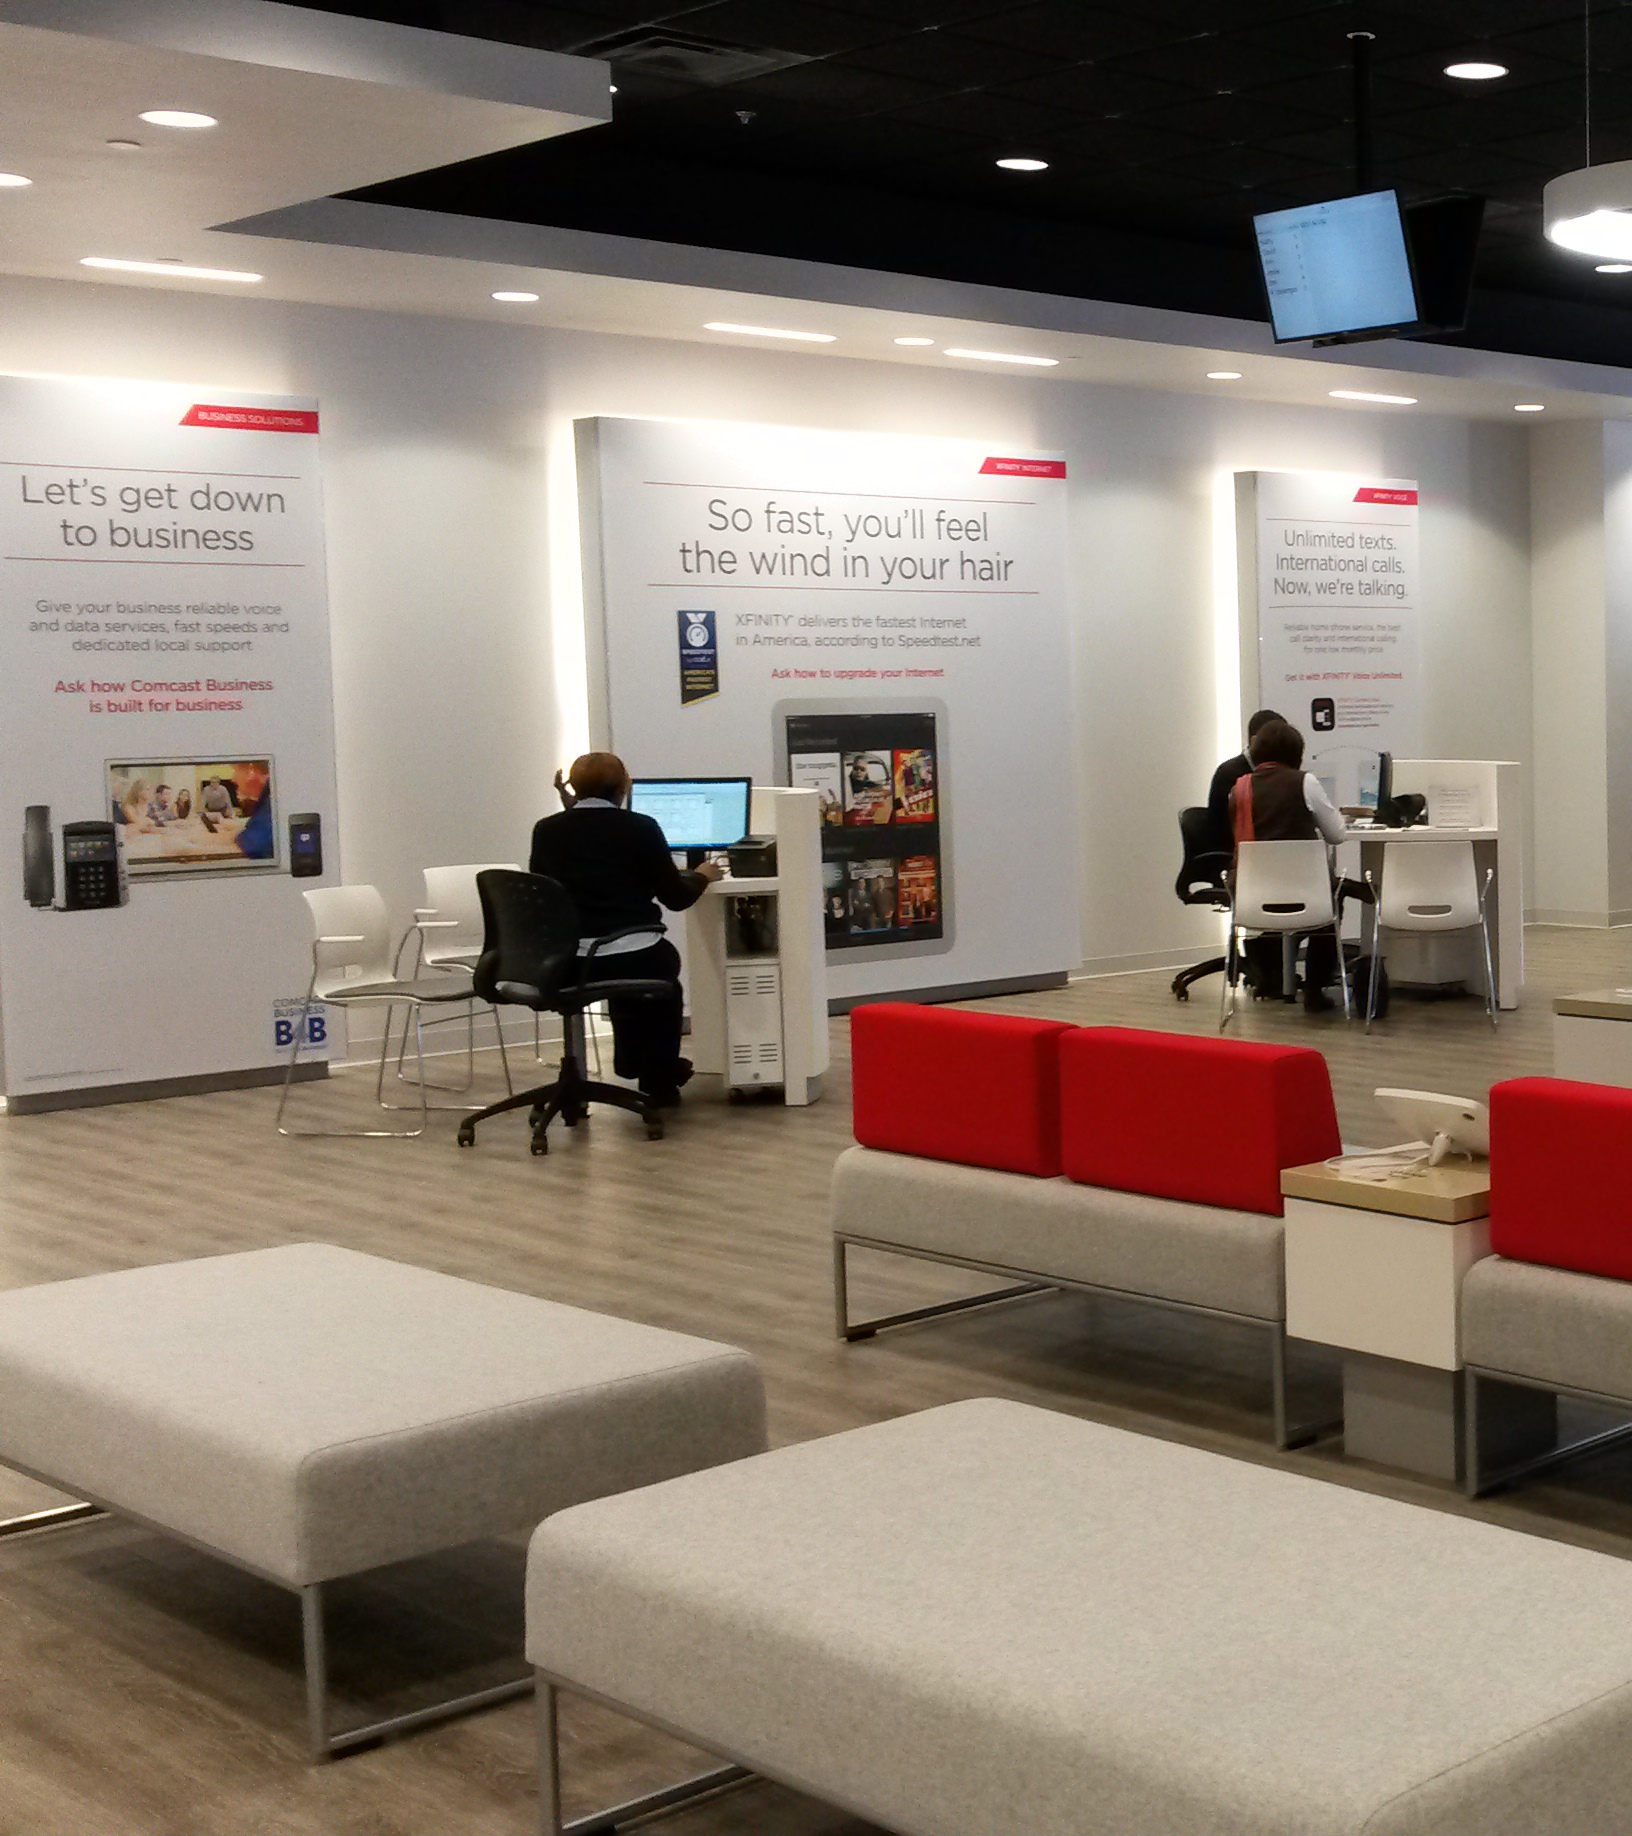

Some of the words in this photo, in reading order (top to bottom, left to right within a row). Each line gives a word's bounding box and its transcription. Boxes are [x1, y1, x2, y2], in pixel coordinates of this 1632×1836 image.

[21, 475, 107, 507] Let's
[119, 483, 179, 514] get
[190, 482, 286, 514] down
[707, 498, 753, 533] So
[764, 501, 833, 540] fast,
[843, 508, 925, 543] you'll
[935, 510, 988, 542] feel
[60, 518, 98, 548] to
[108, 519, 255, 551] business
[1284, 529, 1355, 548] Unlimited
[1359, 533, 1397, 550] texts.
[679, 541, 738, 575] the
[749, 544, 831, 578] wind
[843, 547, 869, 578] in
[881, 554, 949, 585] your
[959, 550, 1014, 582] hair
[1276, 553, 1367, 573] International
[1372, 556, 1405, 574] calls.
[1274, 577, 1311, 597] Now,
[1315, 578, 1354, 595] we're
[1358, 579, 1408, 600] talking.
[36, 600, 72, 614] Give
[76, 603, 112, 616] your
[116, 601, 181, 614] business
[186, 601, 239, 615] reliable
[244, 603, 282, 615] voice
[29, 619, 60, 633] and
[64, 619, 99, 633] data
[104, 620, 170, 635] services,
[174, 619, 201, 633] fast
[206, 620, 257, 635] speeds
[262, 620, 289, 634] and
[798, 614, 848, 628] delivers
[852, 614, 872, 628] the
[875, 615, 916, 629] fastest
[920, 616, 967, 629] Internet
[71, 638, 150, 652] dedicated
[154, 638, 190, 651] local
[736, 634, 748, 647] in
[752, 634, 811, 648] America,
[814, 635, 878, 649] according
[881, 635, 895, 647] to
[771, 668, 791, 679] Ask
[794, 668, 816, 679] how
[820, 669, 831, 679] to
[834, 670, 877, 680] upgrade
[881, 670, 903, 680] your
[54, 680, 86, 693] Ask
[90, 680, 125, 693] how
[131, 679, 202, 693] Comcast
[206, 678, 274, 692] Business
[88, 699, 102, 713] is
[107, 699, 143, 713] built
[148, 699, 171, 713] for
[175, 699, 243, 712] business
